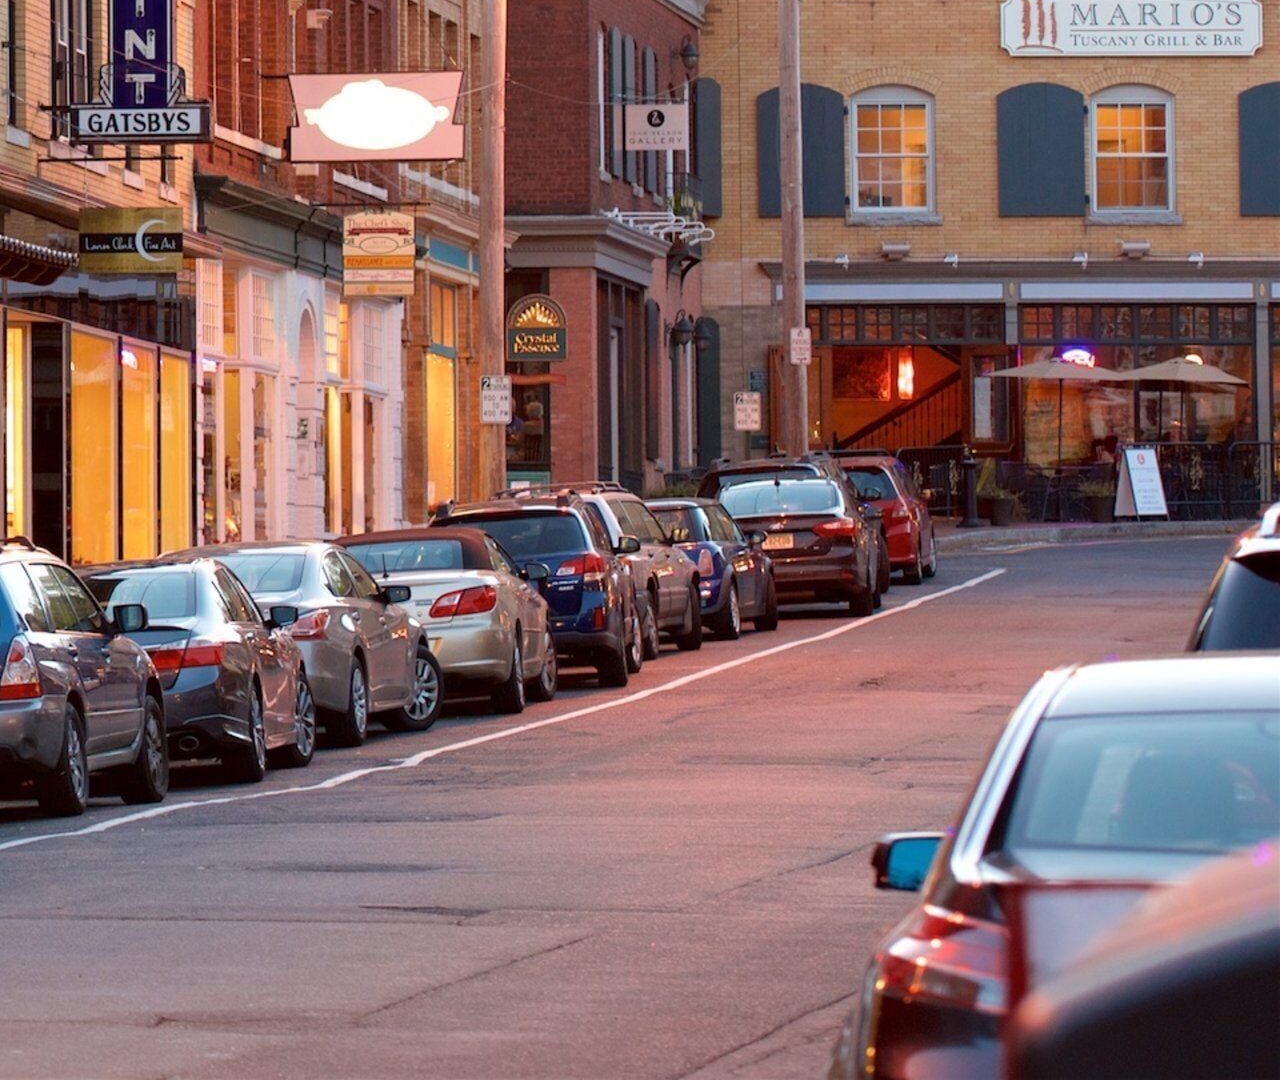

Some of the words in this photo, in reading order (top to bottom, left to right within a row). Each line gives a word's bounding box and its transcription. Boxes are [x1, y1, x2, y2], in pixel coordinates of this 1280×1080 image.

[1069, 2, 1242, 27] MARIO'S
[1195, 34, 1207, 46] &
[87, 110, 192, 134] GATSBYS
